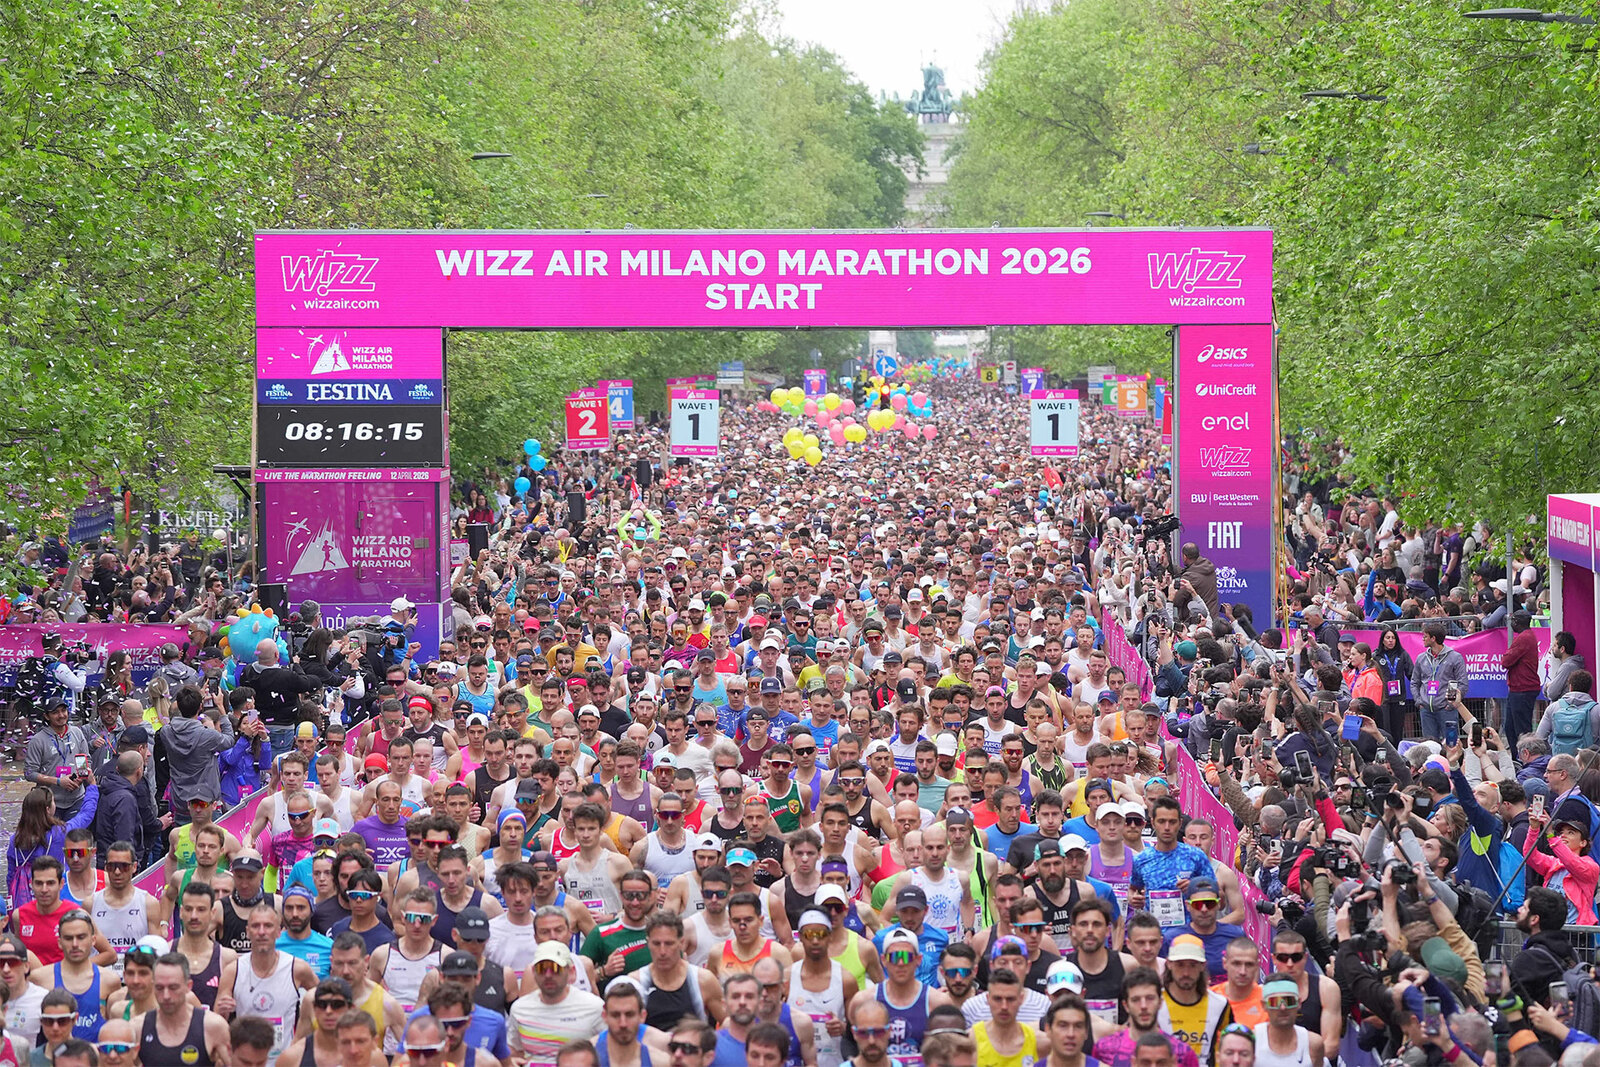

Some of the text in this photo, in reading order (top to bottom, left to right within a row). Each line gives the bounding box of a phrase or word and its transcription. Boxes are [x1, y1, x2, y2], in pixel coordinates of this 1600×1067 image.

[435, 246, 1092, 276] WIZZ AIR MILANO MARATHON 2026
[705, 283, 823, 310] START
[1169, 295, 1246, 307] wizzair.com
[303, 297, 380, 309] wizzair.com
[352, 346, 393, 354] WIZZ AIR
[352, 354, 393, 363] MILANO
[986, 371, 993, 382] 8
[1027, 378, 1038, 393] 7
[1209, 384, 1256, 396] UniCredit
[306, 383, 394, 401] FESTINA
[570, 400, 602, 409] WAVE 1
[1125, 390, 1139, 409] 5
[610, 397, 624, 419] 4
[678, 402, 713, 410] WAVE 1
[1037, 402, 1073, 410] WAVE 1
[578, 409, 597, 436] 2
[688, 413, 700, 440] 1
[1202, 411, 1250, 431] enel
[285, 422, 424, 441] 08:16:15
[1047, 413, 1060, 441] 1
[264, 471, 382, 480] LIVE THE MARATHON FEELING
[390, 471, 398, 480] 12
[398, 471, 412, 480] APRIL
[413, 471, 430, 480] 2026
[1213, 493, 1259, 501] Best Western
[352, 536, 411, 545] WIZZ AIR
[1208, 521, 1243, 549] FIAT
[352, 547, 412, 558] MILANO
[352, 560, 411, 568] MARATHON
[1216, 578, 1248, 588] STINA
[1465, 654, 1505, 662] WIZZ AI
[376, 847, 407, 858] DXC
[128, 908, 140, 916] CT
[1053, 910, 1069, 920] AIR
